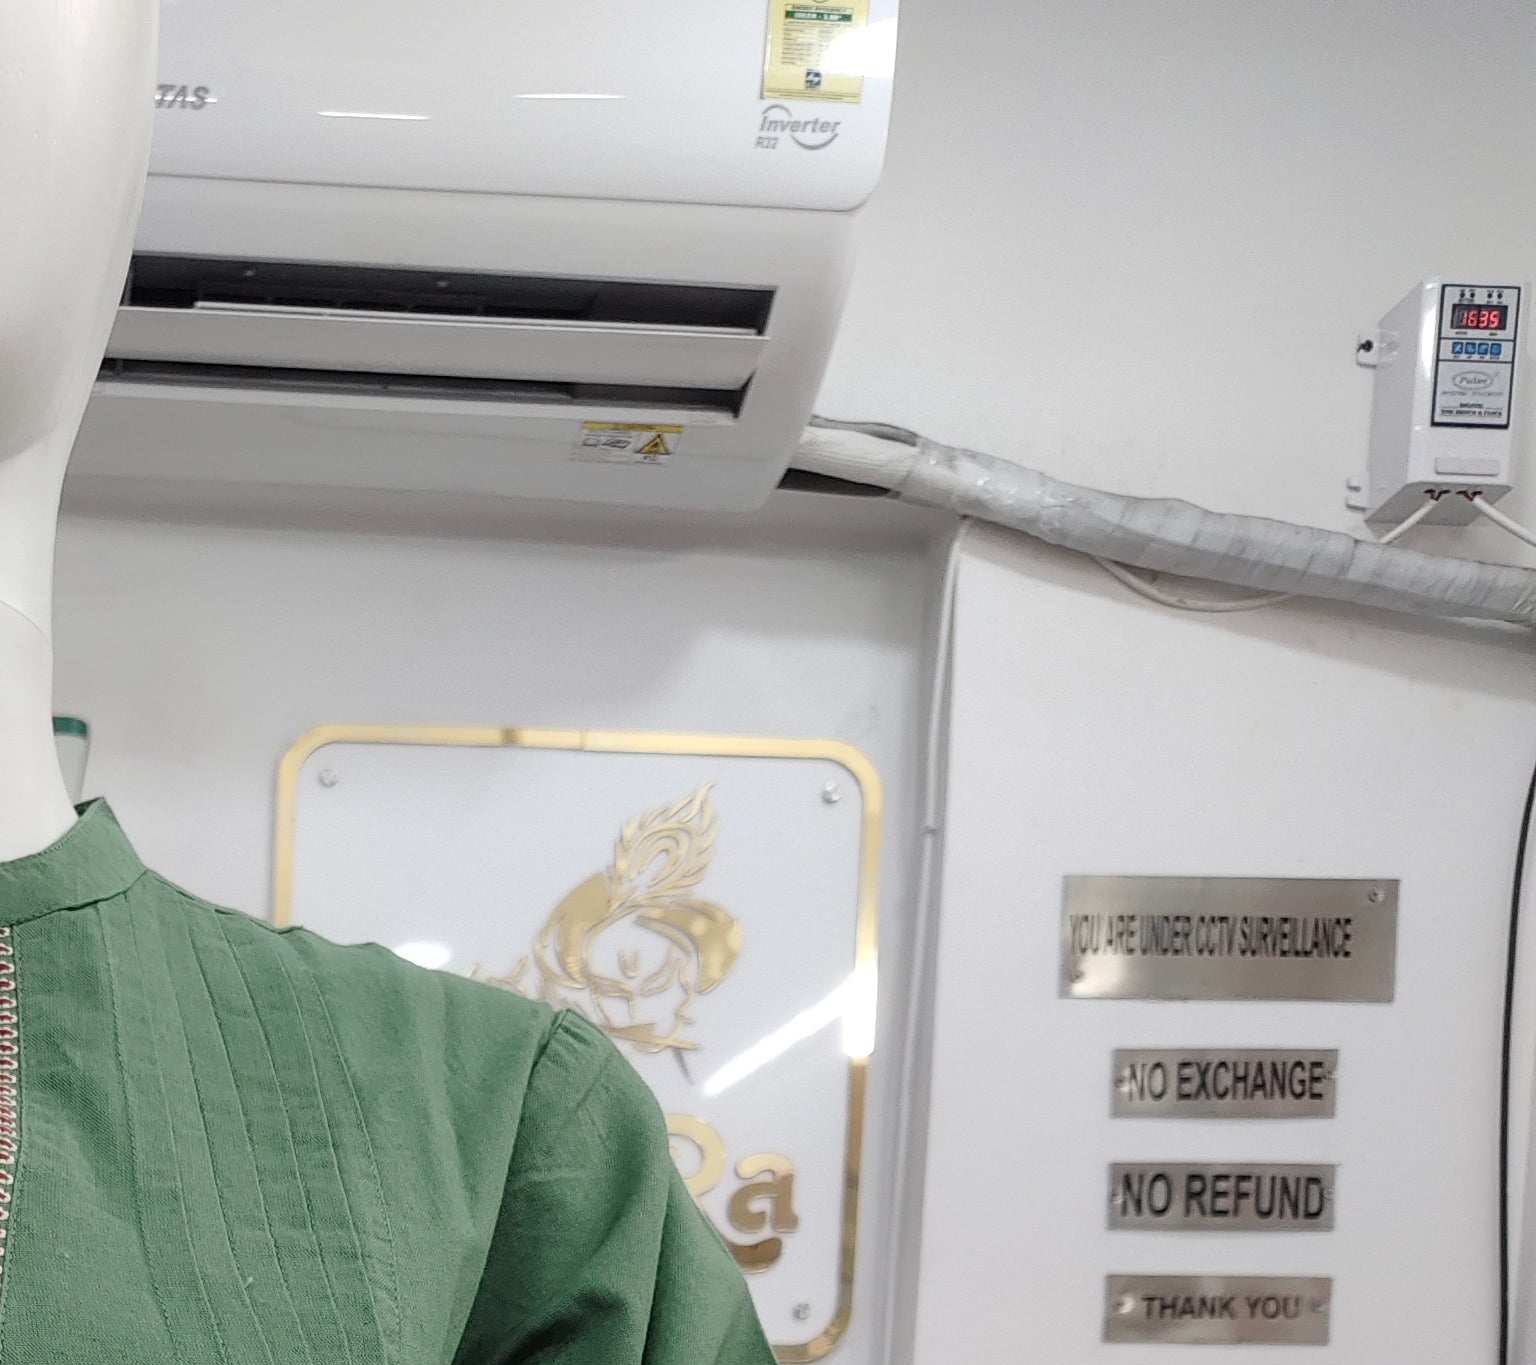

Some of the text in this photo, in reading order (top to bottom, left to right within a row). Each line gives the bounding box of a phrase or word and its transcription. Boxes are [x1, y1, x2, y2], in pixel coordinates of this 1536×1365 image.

[155, 84, 211, 110] TAS
[759, 115, 842, 134] Inverter
[1462, 308, 1500, 328] 1635
[1070, 914, 1353, 959] YOU ARE UNDER CCTV SURVEILLANCE
[1126, 1061, 1325, 1101] NO EXCHANGE
[1119, 1172, 1326, 1221] NO REFUND
[1142, 1295, 1301, 1321] THANK YOU
